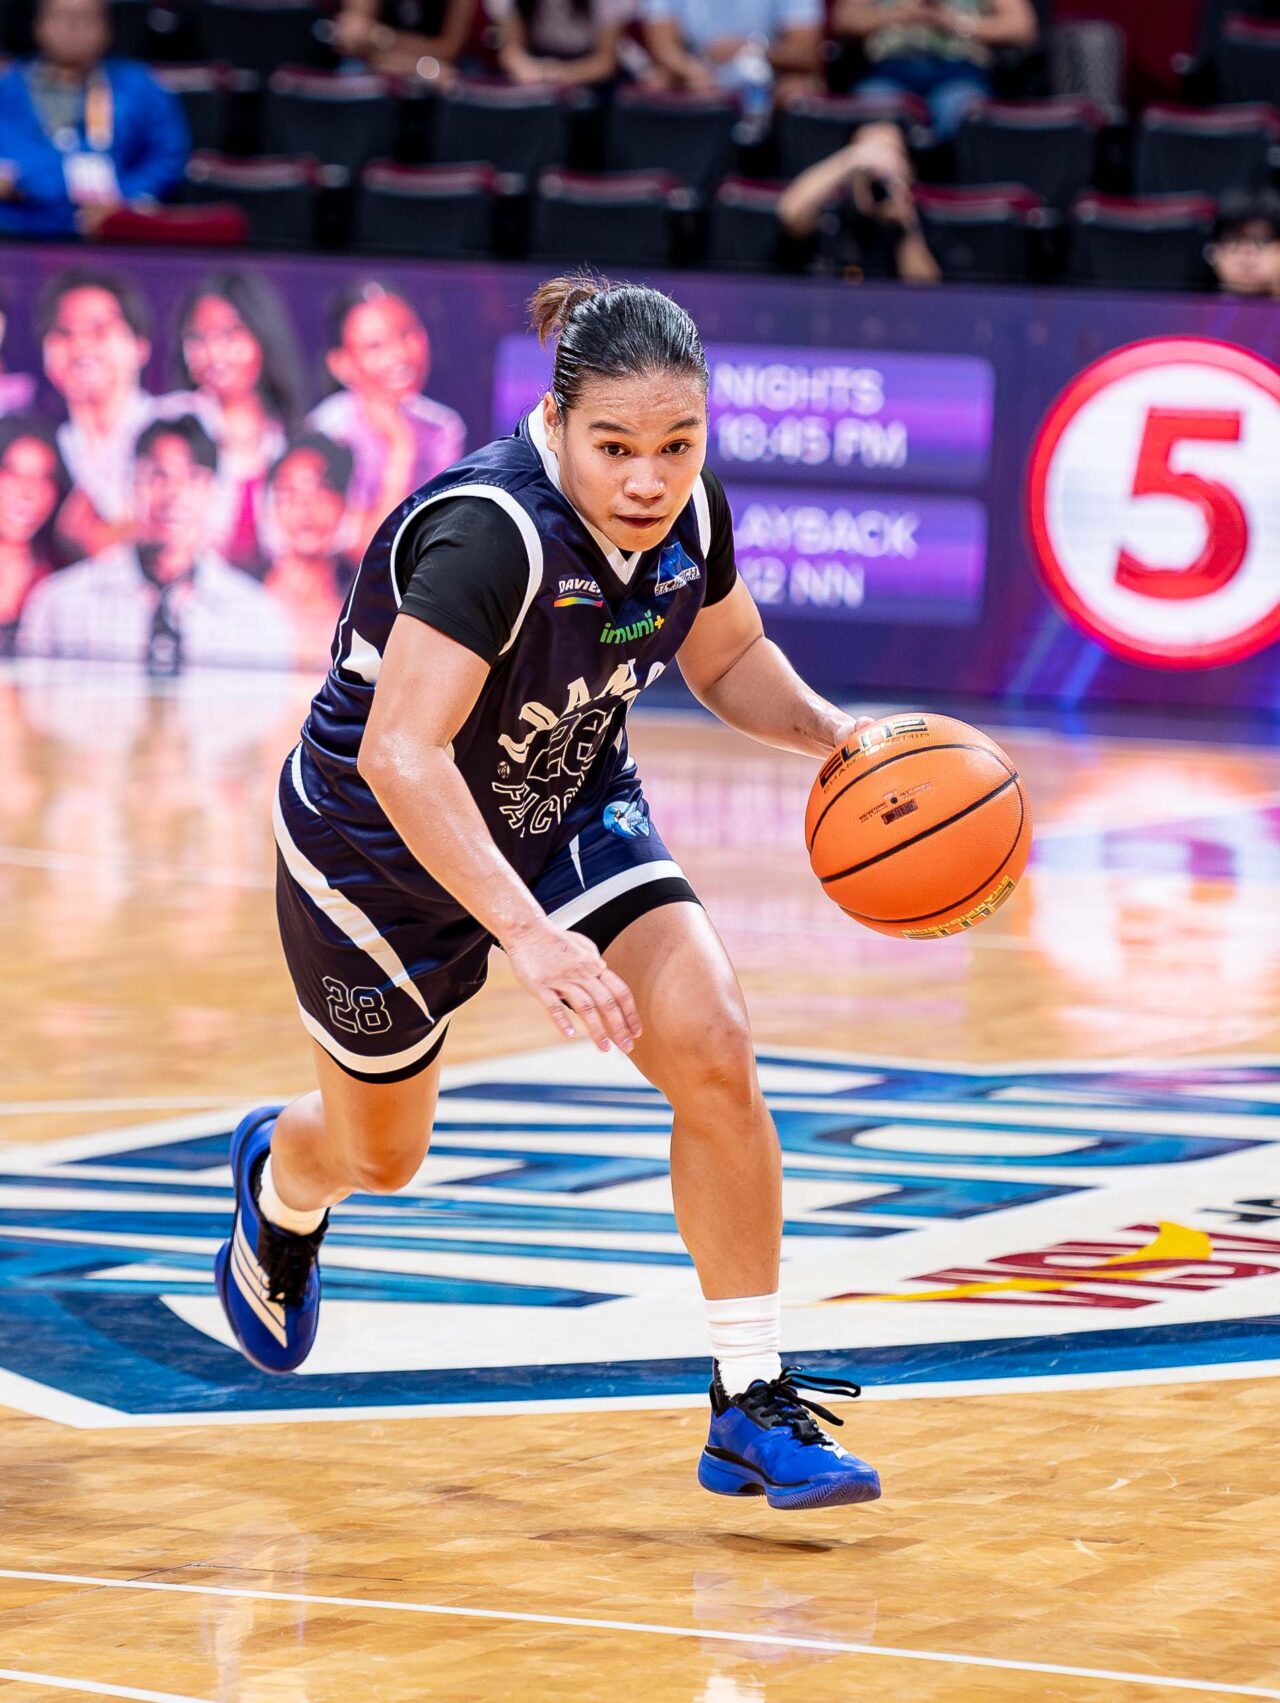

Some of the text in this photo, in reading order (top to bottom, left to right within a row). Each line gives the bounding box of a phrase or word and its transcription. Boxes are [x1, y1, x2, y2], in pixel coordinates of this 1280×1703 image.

[832, 417, 908, 469] PM
[734, 503, 920, 560] AYBACK
[1115, 407, 1248, 600] 5
[789, 557, 865, 608] NN
[321, 975, 393, 1035] 28
